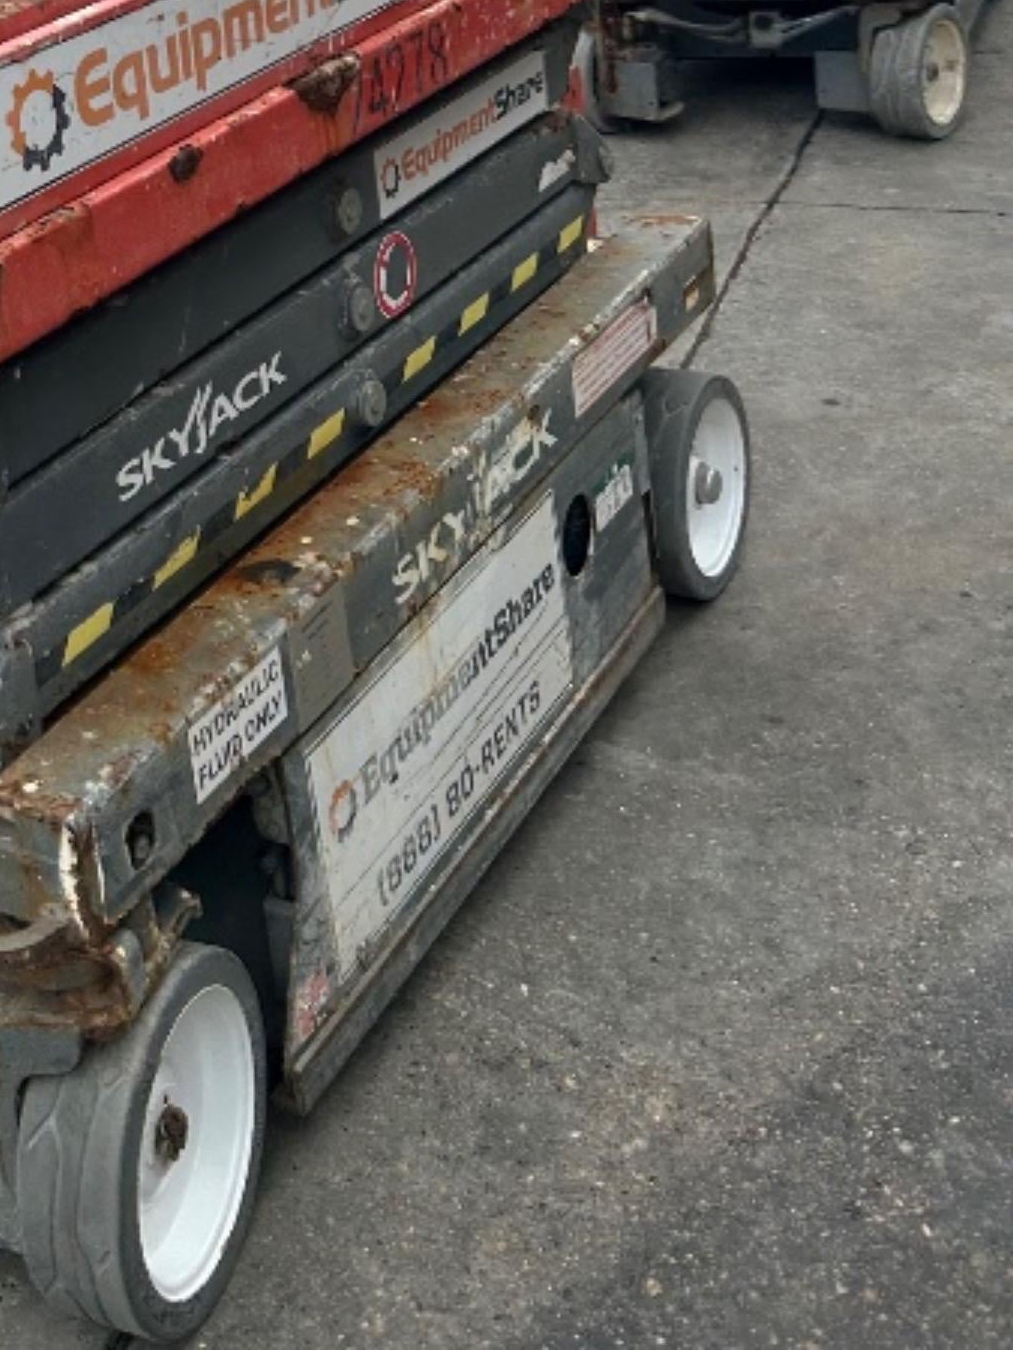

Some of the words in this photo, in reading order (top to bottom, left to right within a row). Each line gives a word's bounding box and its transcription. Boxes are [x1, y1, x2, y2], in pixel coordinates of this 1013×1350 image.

[401, 71, 543, 180] EquipmentShare
[115, 350, 287, 501] SKYJACK
[193, 659, 279, 752] HYDRAULIC
[359, 563, 556, 805] EquipmentShare
[198, 735, 243, 790] FLUID
[445, 681, 541, 819] 80-RENTS
